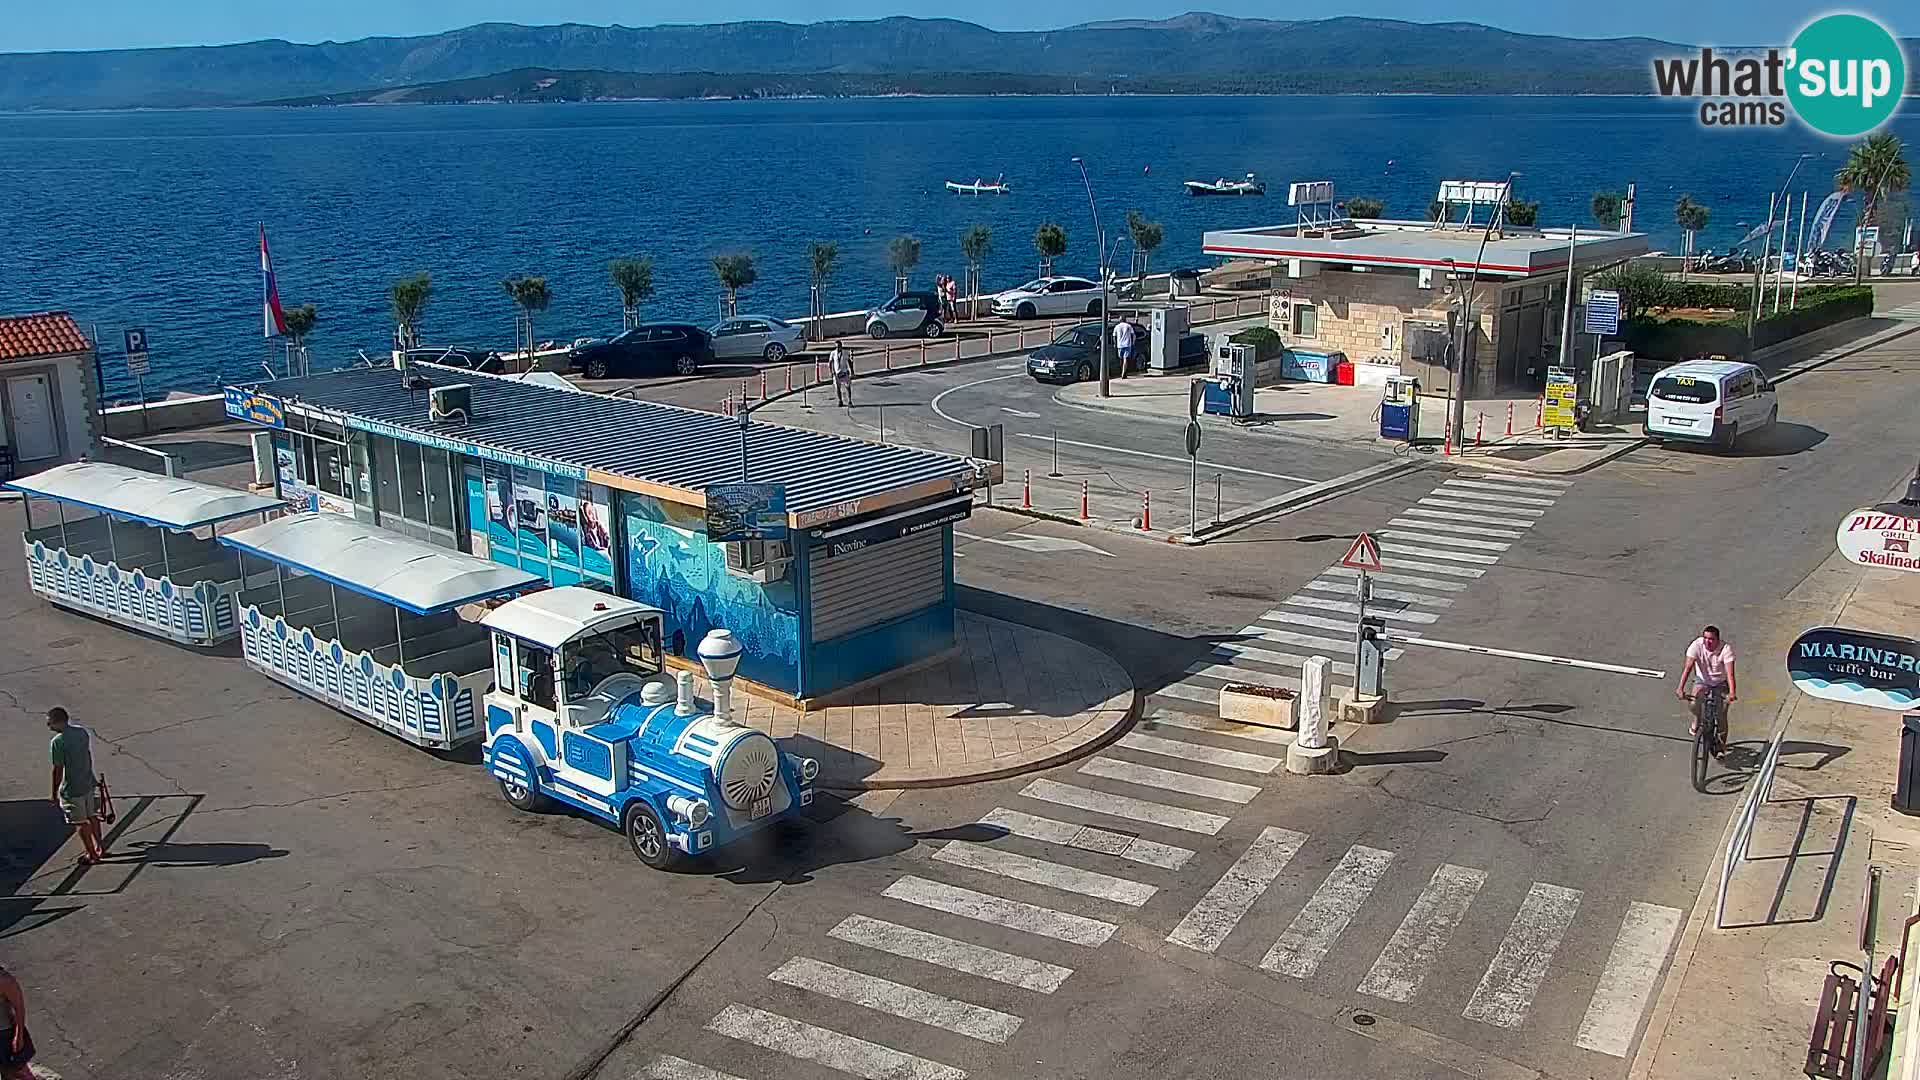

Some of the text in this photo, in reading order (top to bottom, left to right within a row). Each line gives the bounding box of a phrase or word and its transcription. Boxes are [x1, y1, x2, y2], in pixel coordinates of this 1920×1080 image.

[1677, 377, 1695, 386] TAXI
[435, 438, 467, 453] POSTAJA
[477, 447, 581, 477] BUS STATION TICKET OFFICE
[1881, 530, 1917, 540] GRILL
[1828, 662, 1896, 680] caffe bar
